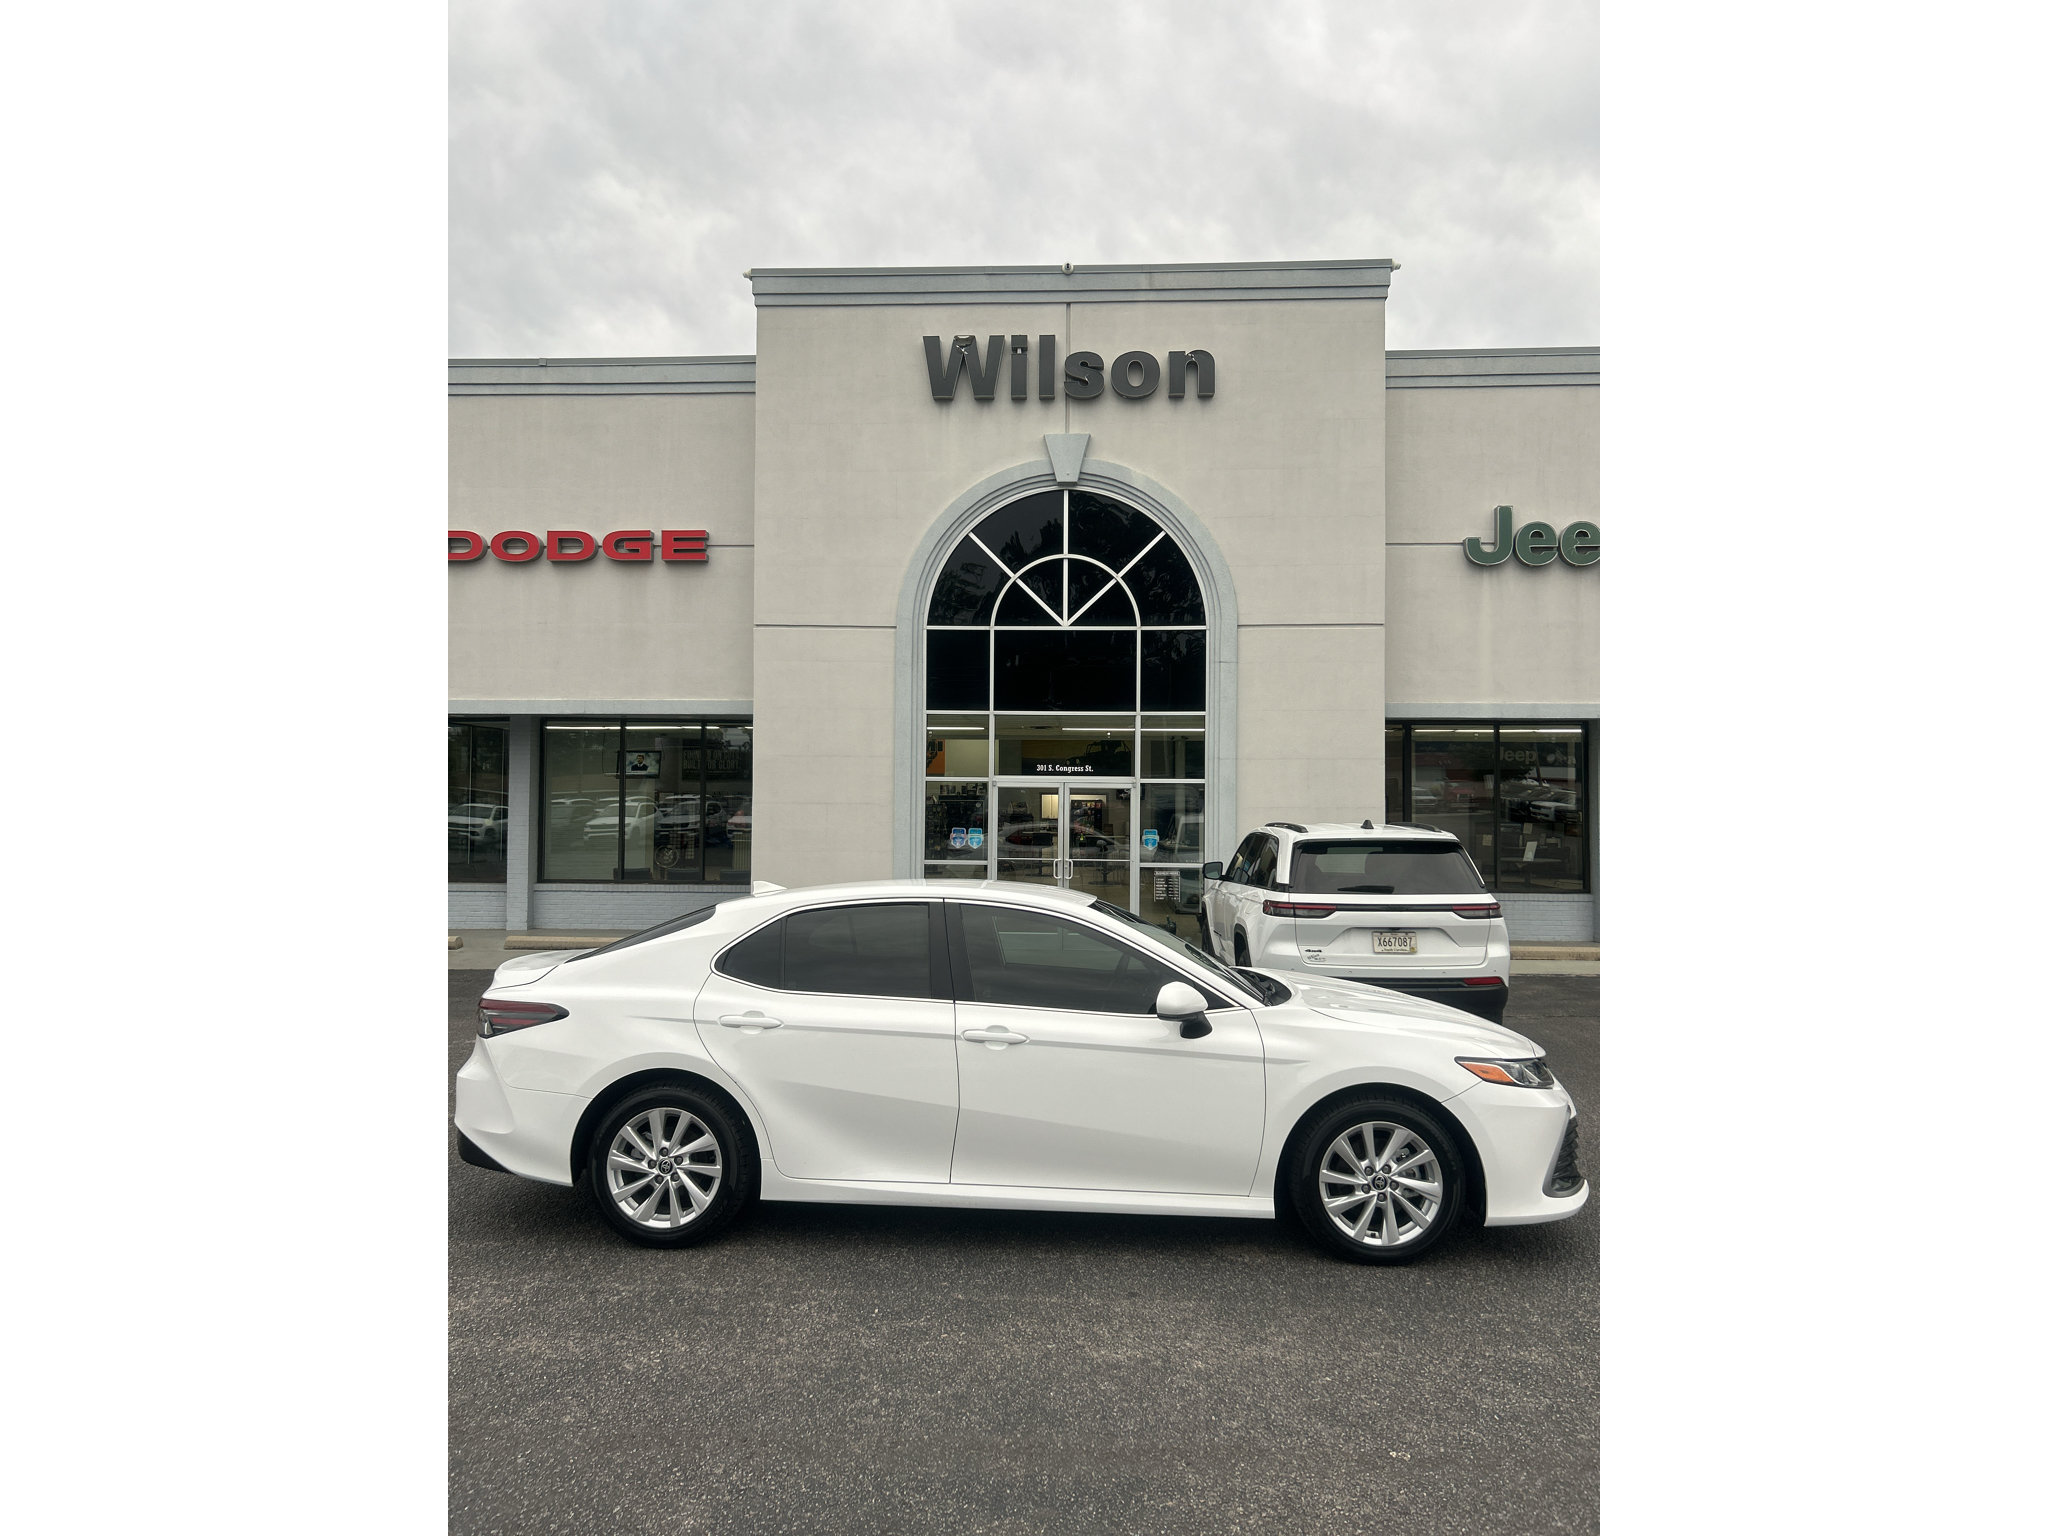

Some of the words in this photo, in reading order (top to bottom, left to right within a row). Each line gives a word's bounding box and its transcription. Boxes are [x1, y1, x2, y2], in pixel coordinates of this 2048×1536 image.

[923, 334, 1216, 400] Wilson
[448, 529, 709, 563] DODGE
[1055, 764, 1084, 773] Congress
[1377, 936, 1413, 947] X667087
